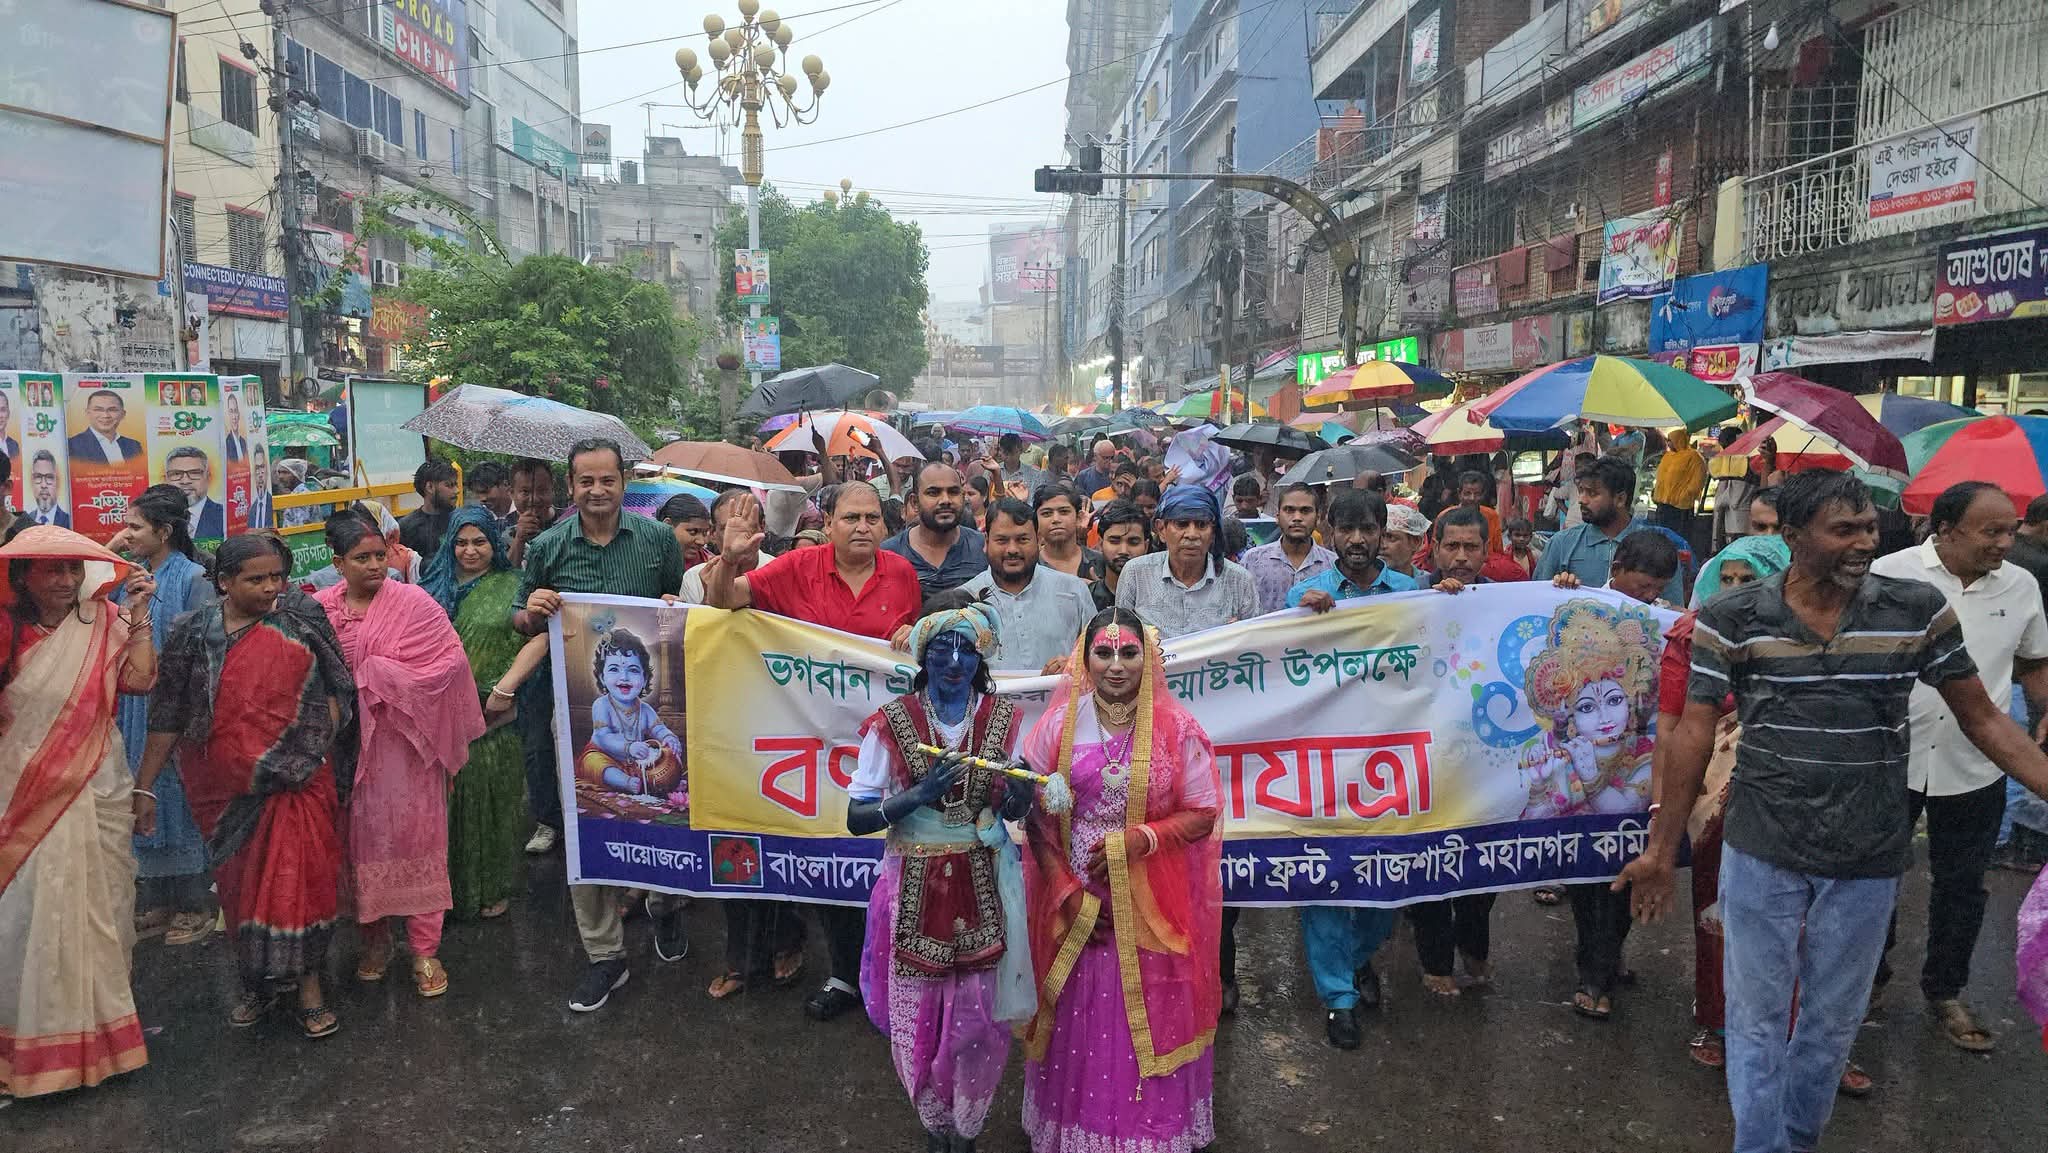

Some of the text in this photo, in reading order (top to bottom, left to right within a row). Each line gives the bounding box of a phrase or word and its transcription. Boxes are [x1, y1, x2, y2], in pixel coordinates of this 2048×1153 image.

[396, 24, 457, 86] CHINA
[1874, 145, 1894, 165] এই
[1897, 136, 1941, 161] পজিশন
[1886, 156, 1959, 188] দেওয়া হইবে
[184, 263, 235, 285] CONNECTEDU
[236, 273, 286, 293] CONSULTANTS
[1946, 239, 2036, 287] আশুতোষ
[761, 653, 875, 701] ভগবান
[1165, 644, 1420, 702] ন্মাষ্টমী উপলক্ষে
[1214, 731, 1432, 820] াযাত্রা
[1265, 843, 1340, 894] ফ্রন্ট,
[1350, 833, 1469, 889] রাজশাহী
[1475, 831, 1584, 875] মহানগর
[1589, 818, 1650, 863] কমি
